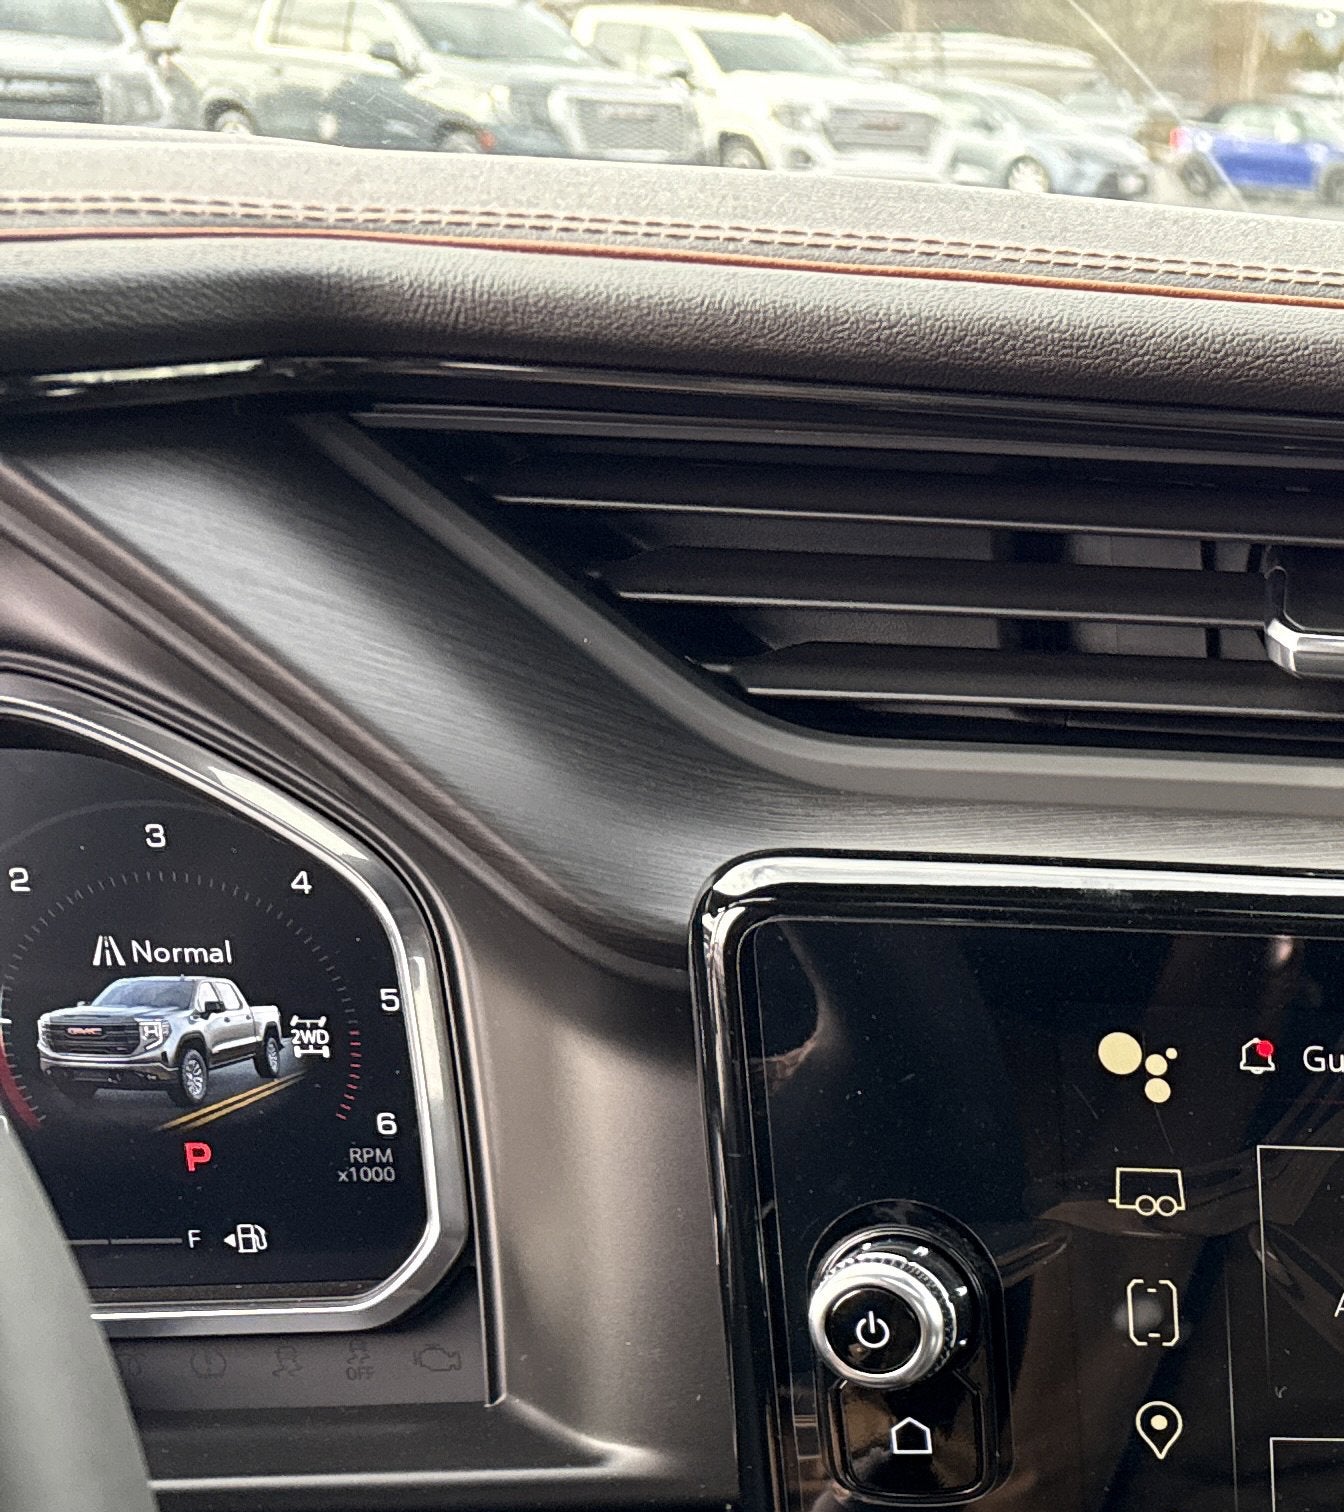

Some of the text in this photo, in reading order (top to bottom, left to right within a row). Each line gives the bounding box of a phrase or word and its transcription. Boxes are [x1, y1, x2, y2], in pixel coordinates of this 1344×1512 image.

[145, 824, 166, 849] 3
[9, 868, 30, 892] 2
[290, 871, 312, 894] 4
[131, 939, 233, 965] Normal
[380, 989, 399, 1012] 5
[291, 1028, 330, 1048] 2WD
[376, 1112, 398, 1136] 6
[184, 1142, 212, 1172] P
[349, 1147, 394, 1165] RPM
[337, 1166, 395, 1183] x1000
[188, 1230, 201, 1249] F
